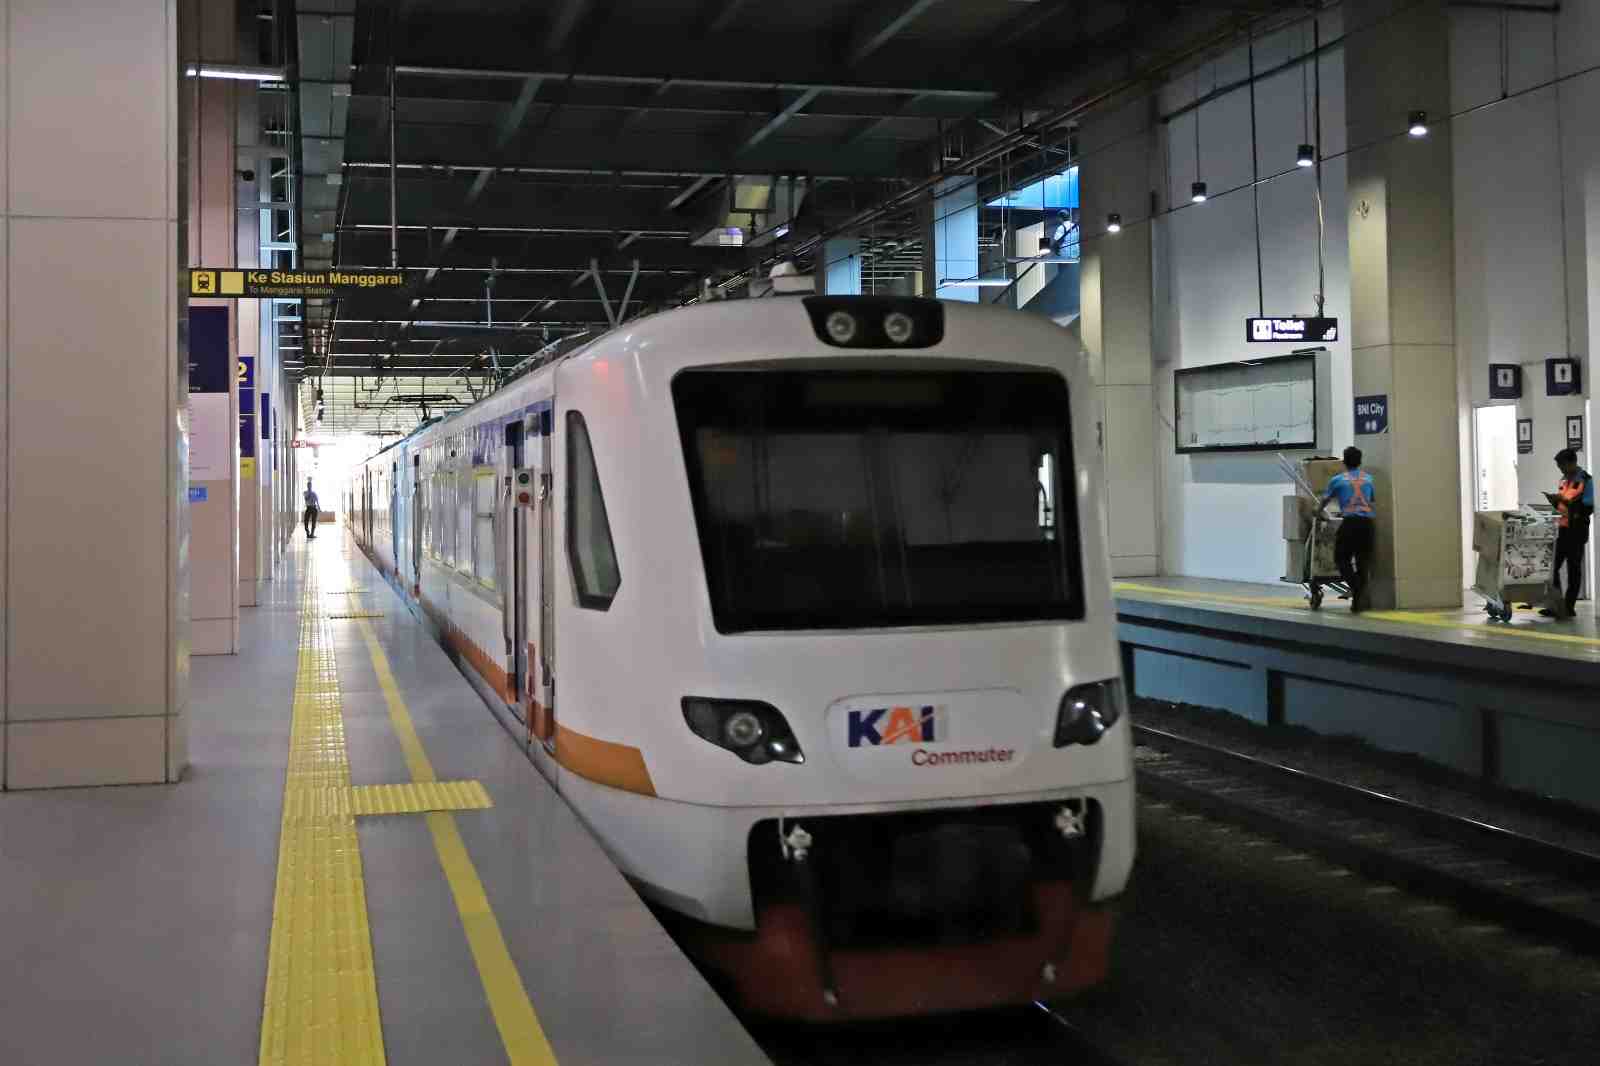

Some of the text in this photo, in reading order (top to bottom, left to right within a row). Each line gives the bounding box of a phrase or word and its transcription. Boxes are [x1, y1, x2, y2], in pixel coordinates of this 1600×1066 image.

[248, 272, 402, 287] Ke Stasiun Manggarai
[1273, 319, 1305, 331] Toilet
[1370, 402, 1384, 417] City
[847, 705, 935, 748] KAI
[911, 748, 1016, 766] Commuter
